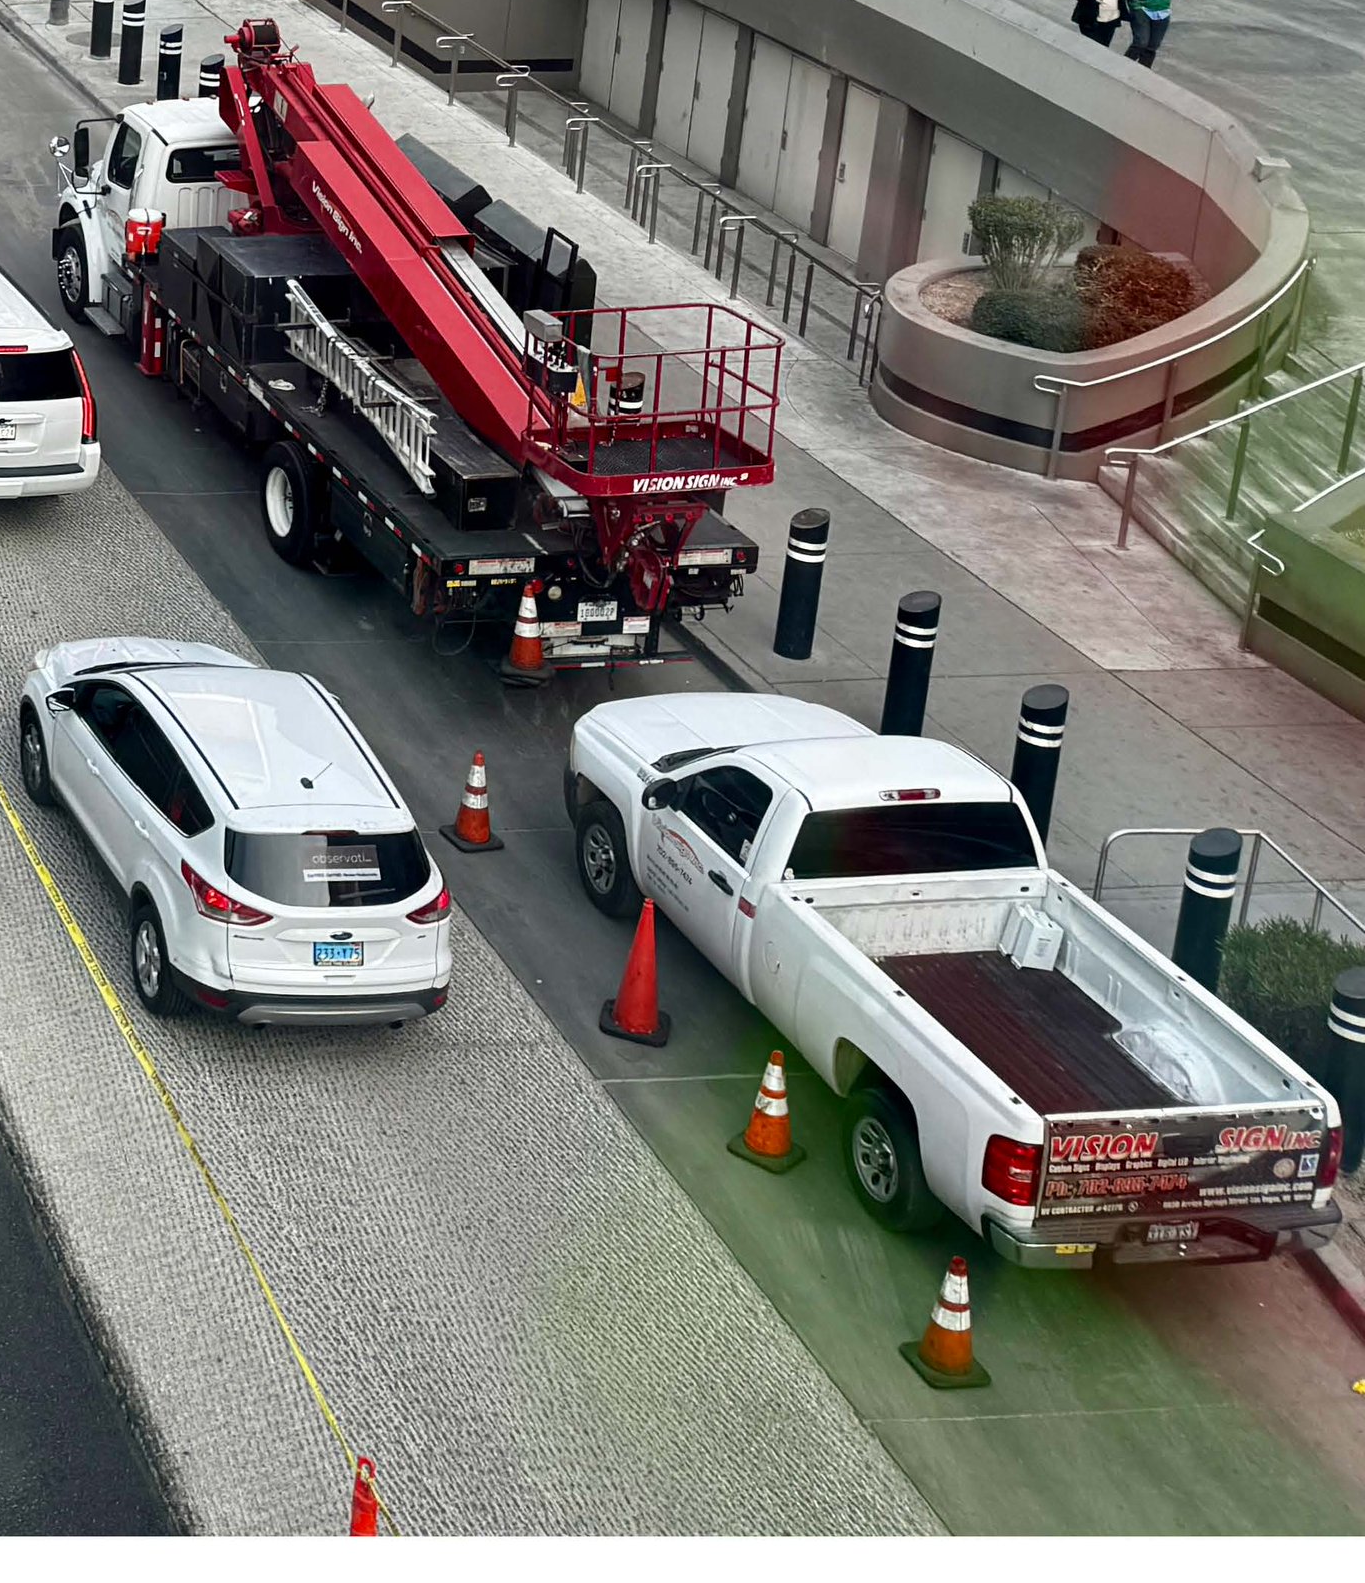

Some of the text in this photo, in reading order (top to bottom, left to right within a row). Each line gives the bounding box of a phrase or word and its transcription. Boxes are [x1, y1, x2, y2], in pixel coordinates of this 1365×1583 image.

[312, 180, 333, 215] Vision
[332, 209, 349, 236] Sign
[633, 476, 685, 493] VISION
[685, 473, 720, 489] SIGN
[1049, 1124, 1322, 1162] VISION SIGN INC
